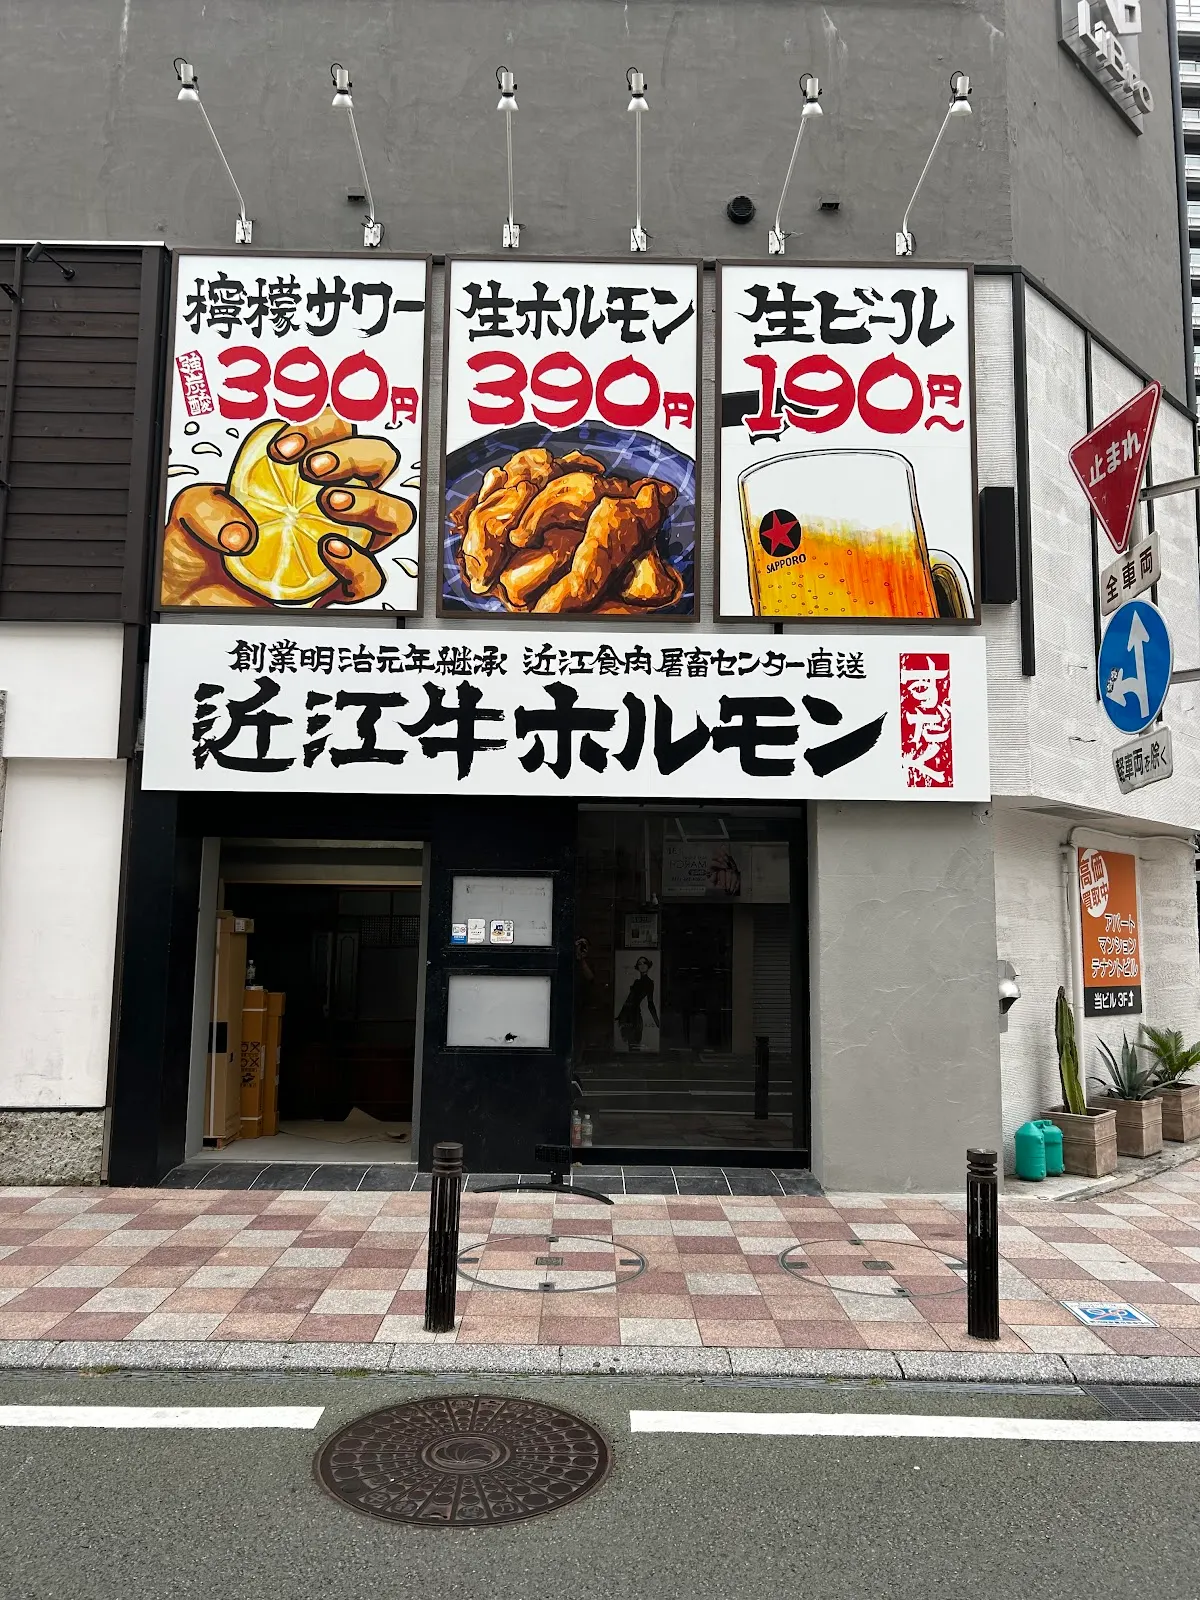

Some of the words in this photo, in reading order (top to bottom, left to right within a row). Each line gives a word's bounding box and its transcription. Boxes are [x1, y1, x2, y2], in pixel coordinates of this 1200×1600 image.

[183, 271, 426, 340] 檸檬サワー
[457, 280, 696, 344] 生ホルモン
[736, 281, 955, 348] 生ビール
[178, 350, 213, 416] 強炭酸
[1087, 429, 1141, 488] 止まれ
[766, 553, 807, 574] SAPPORO
[1105, 552, 1154, 603] 全車両
[226, 639, 508, 677] 創業明治元年継承
[523, 643, 867, 679] 近江食肉屠畜センター直送
[192, 676, 888, 780] 近江牛ホルモン
[900, 655, 951, 785] すだく
[1116, 741, 1167, 784] 軽車両を除く
[1079, 853, 1104, 889] 高価
[1098, 936, 1136, 956] マンション
[1104, 913, 1135, 934] アパート
[1091, 958, 1138, 979] テナントビル
[1094, 992, 1116, 1010] 当ビル
[1117, 991, 1128, 1008] 3F
